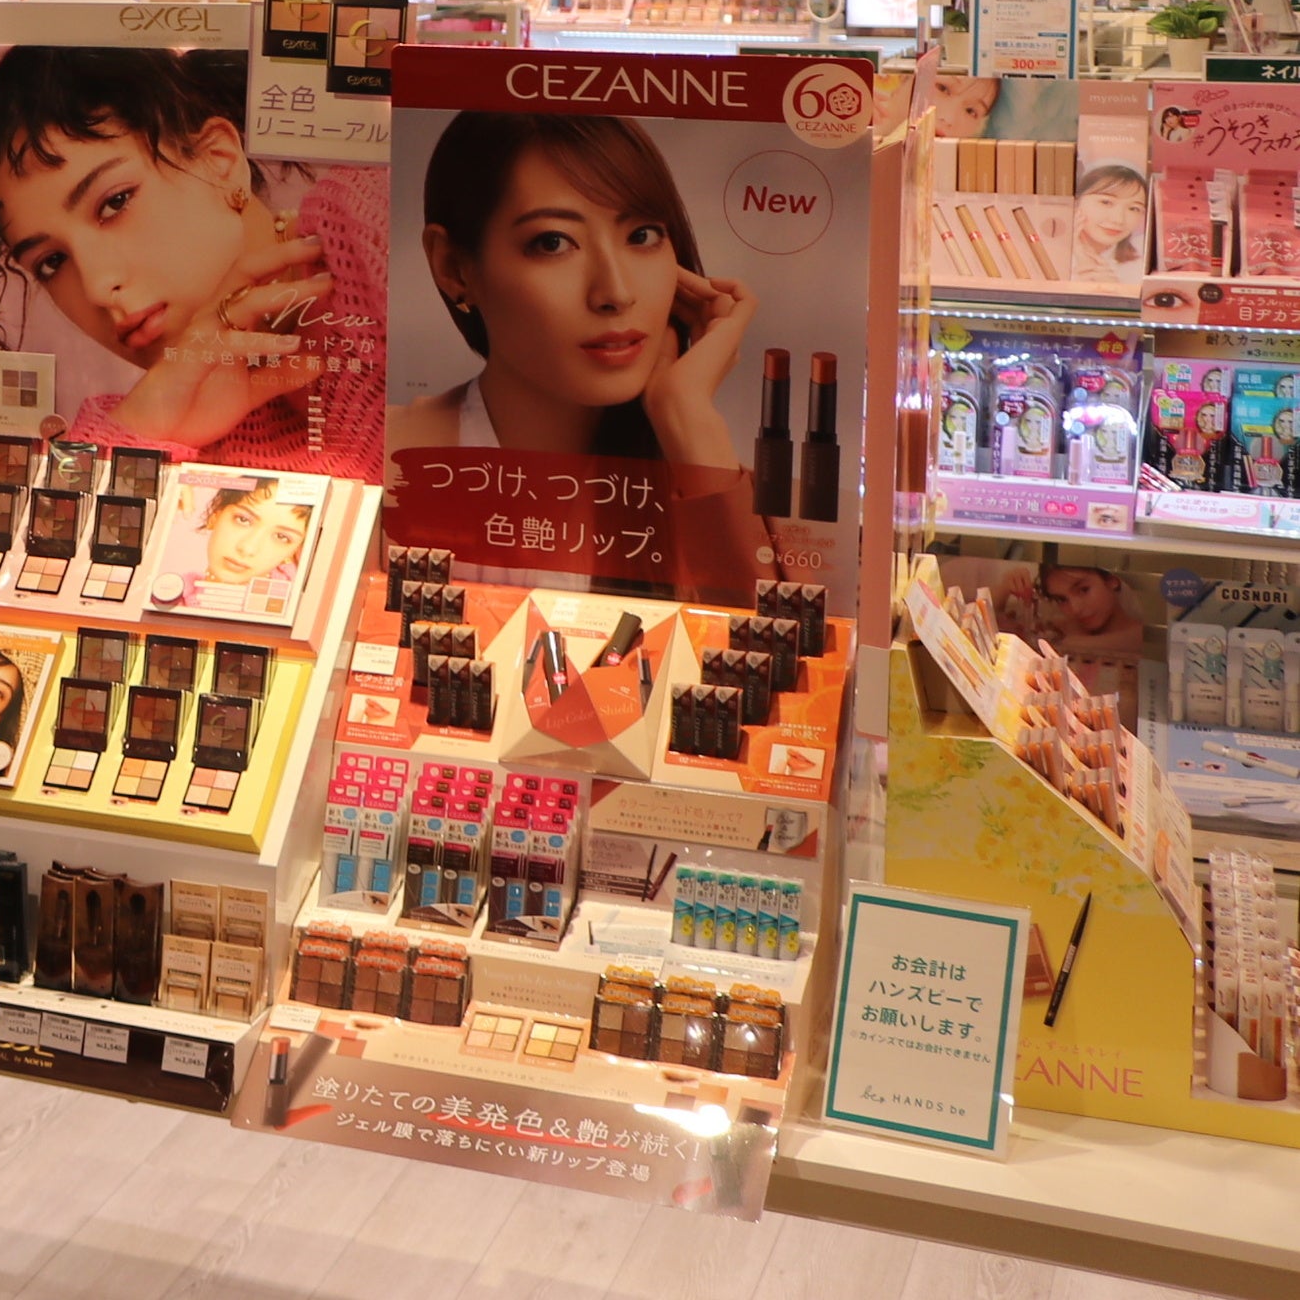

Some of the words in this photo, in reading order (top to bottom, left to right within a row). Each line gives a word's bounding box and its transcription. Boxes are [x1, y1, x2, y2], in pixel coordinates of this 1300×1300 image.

[1011, 58, 1035, 70] 300
[259, 83, 316, 112] 全色
[505, 63, 749, 108] CEZANNE
[1089, 93, 1138, 105] myroink
[256, 116, 389, 143] リニューアル
[795, 120, 857, 135] CEZANNE
[1089, 134, 1137, 146] myroink
[742, 184, 818, 215] New
[270, 287, 377, 330] New
[421, 461, 665, 513] つづけ、つづけ、
[959, 495, 1042, 514] マスカラ下地
[483, 512, 663, 565] 色艶リップ。
[775, 548, 823, 570] ¥660
[1221, 587, 1288, 605] COSNORI
[891, 954, 967, 982] お会計は
[868, 980, 983, 1014] ハンズビーで
[861, 1004, 983, 1043] お願いします。
[849, 1029, 992, 1065] ※カインズではお会計できません
[1014, 1055, 1145, 1099] ANNE
[311, 1074, 701, 1163] 塗りたての美発色&艶が続く!
[892, 1093, 944, 1112] HANDS
[949, 1103, 966, 1117] be
[336, 1111, 652, 1183] ジェル膜で落ちにくい新リップ登場
